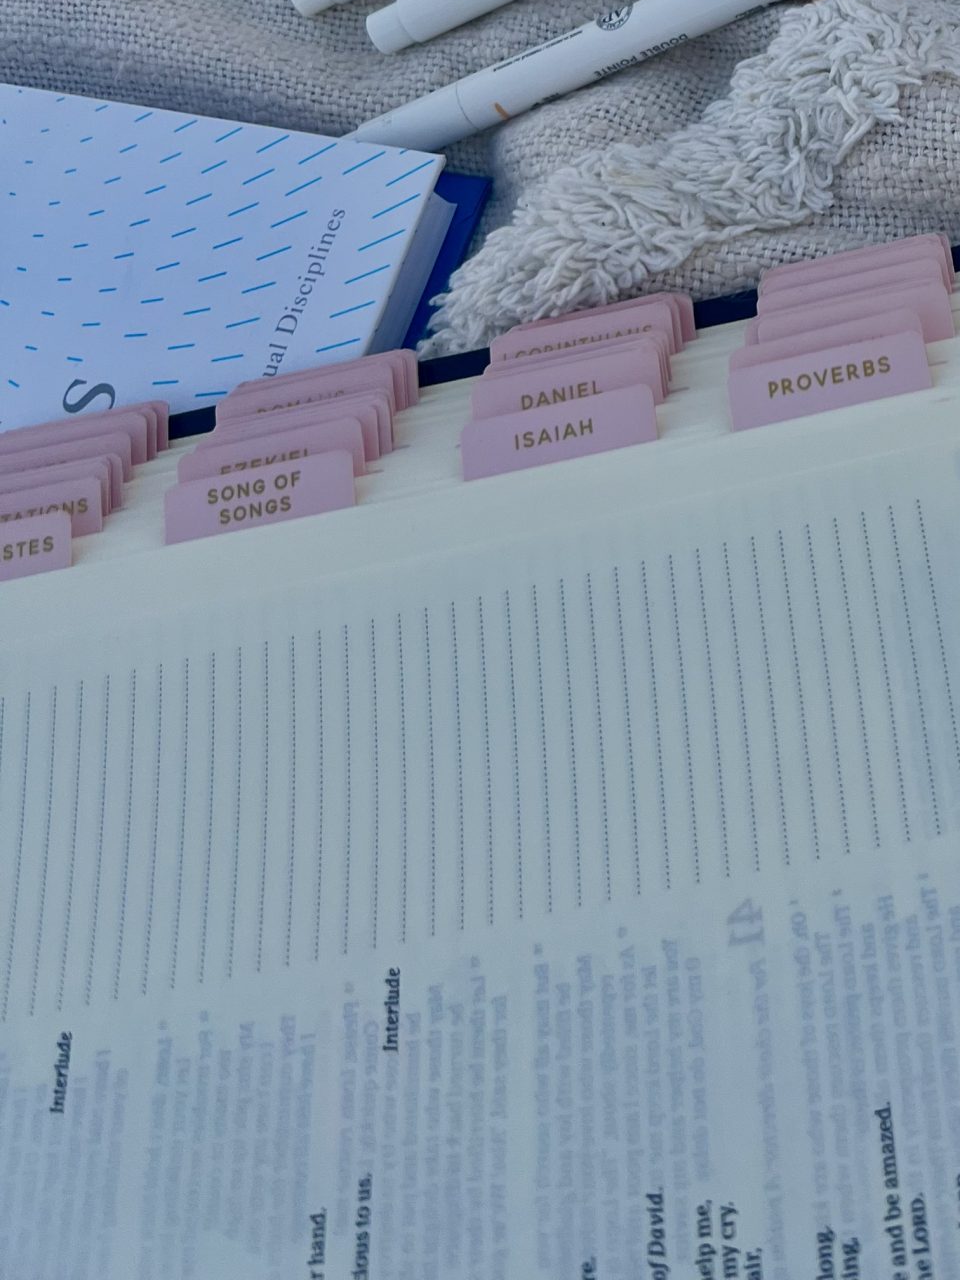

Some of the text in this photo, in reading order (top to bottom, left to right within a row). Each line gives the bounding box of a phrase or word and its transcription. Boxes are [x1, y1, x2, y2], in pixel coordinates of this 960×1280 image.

[594, 33, 689, 77] DOUBLE POINTE
[275, 207, 346, 336] Disciplines
[520, 380, 603, 411] DANIEL
[767, 356, 892, 400] PROVERBS
[514, 418, 594, 451] ISAIAH
[207, 470, 303, 505] SONG OF
[219, 496, 292, 526] SONGS
[2, 535, 54, 561] STES
[383, 967, 400, 1053] Interlude
[50, 1032, 72, 1114] Interlude
[355, 1171, 373, 1202] us.
[874, 1100, 906, 1267] and be amazed.
[305, 1205, 327, 1265] hand.
[353, 1204, 372, 1228] to
[644, 1185, 670, 1280] of David.
[694, 1198, 713, 1239] me,
[909, 1191, 929, 1255] LORD.
[718, 1200, 740, 1279] my cry.
